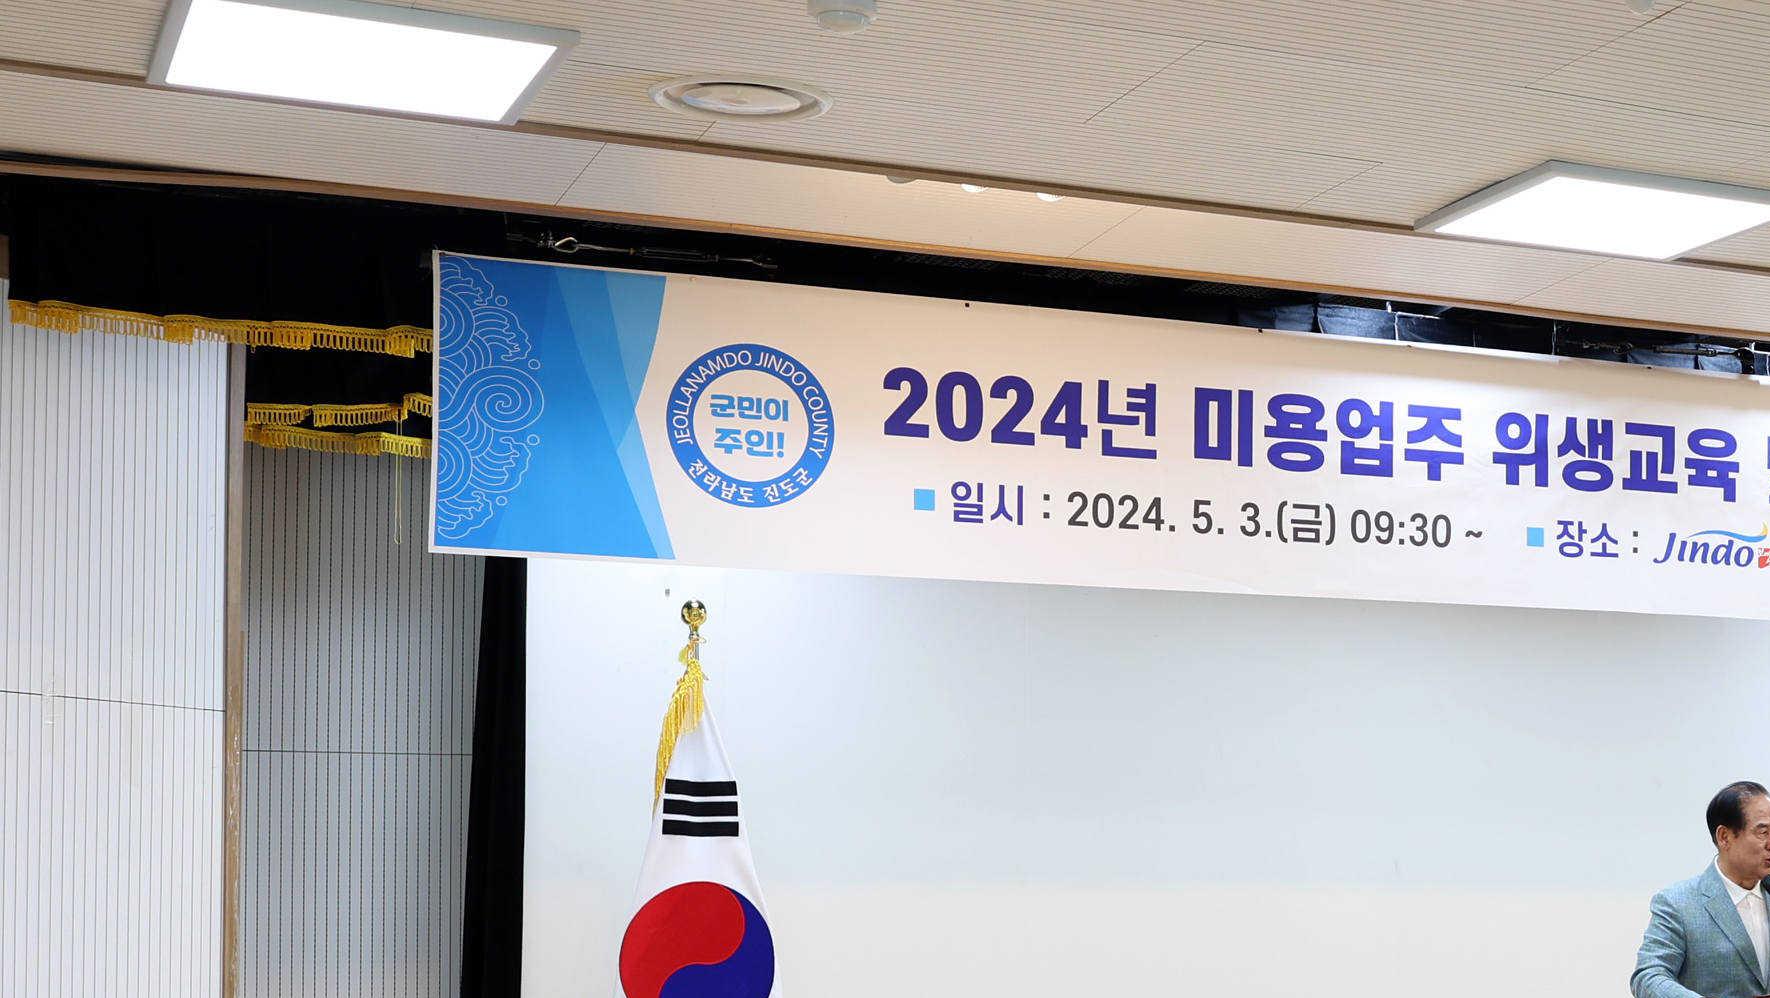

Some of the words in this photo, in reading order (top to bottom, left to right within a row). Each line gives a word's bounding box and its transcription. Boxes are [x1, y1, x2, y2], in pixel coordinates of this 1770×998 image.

[672, 350, 752, 445] JEOLLANAMDO
[755, 351, 807, 387] JINDO
[803, 386, 829, 459] COUNTY
[710, 394, 789, 422] 군민이
[714, 428, 785, 458] 주인!
[883, 367, 1158, 461] 2024년
[1194, 387, 1465, 482] 미용업주
[1492, 412, 1740, 503] 위생교육
[688, 459, 755, 503] 전라남도
[762, 467, 814, 503] 진도군
[950, 480, 1024, 526] 일시
[1067, 490, 1176, 533] 2024.
[1191, 499, 1225, 536] 5.
[1239, 500, 1336, 546] 3.(금)
[1350, 508, 1452, 549] 09:30
[1556, 519, 1620, 559] 장소
[1652, 532, 1755, 568] Jindo
